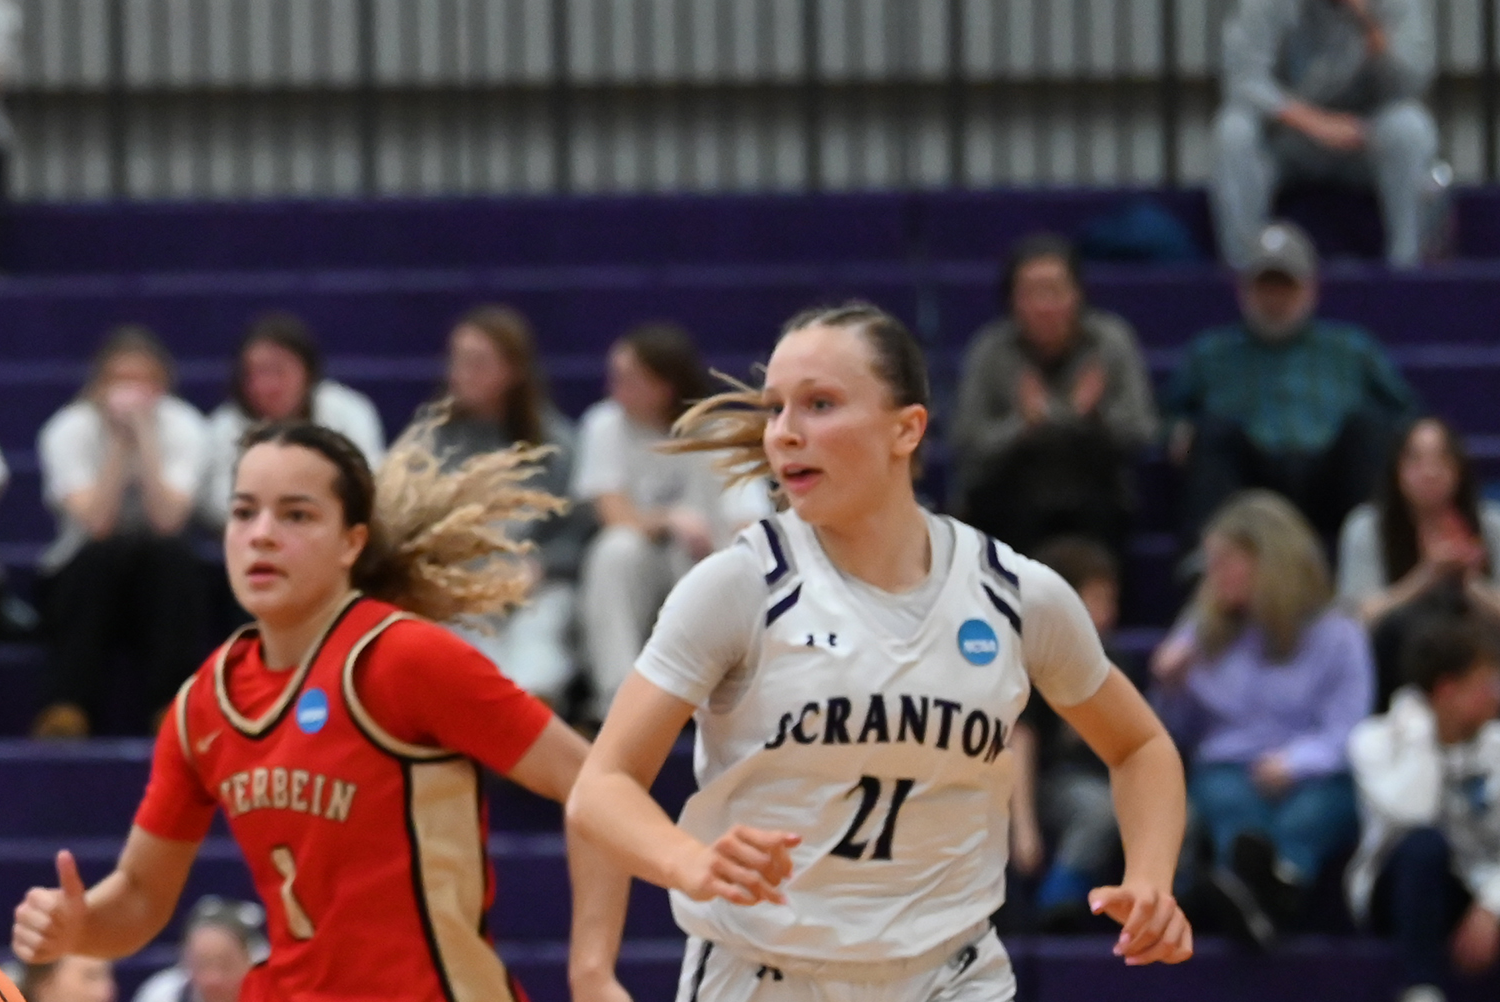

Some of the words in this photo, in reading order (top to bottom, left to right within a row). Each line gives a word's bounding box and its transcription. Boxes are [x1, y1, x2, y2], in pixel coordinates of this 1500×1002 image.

[764, 694, 1008, 764] SCRANTON
[828, 774, 916, 861] 21
[270, 844, 316, 941] 1
